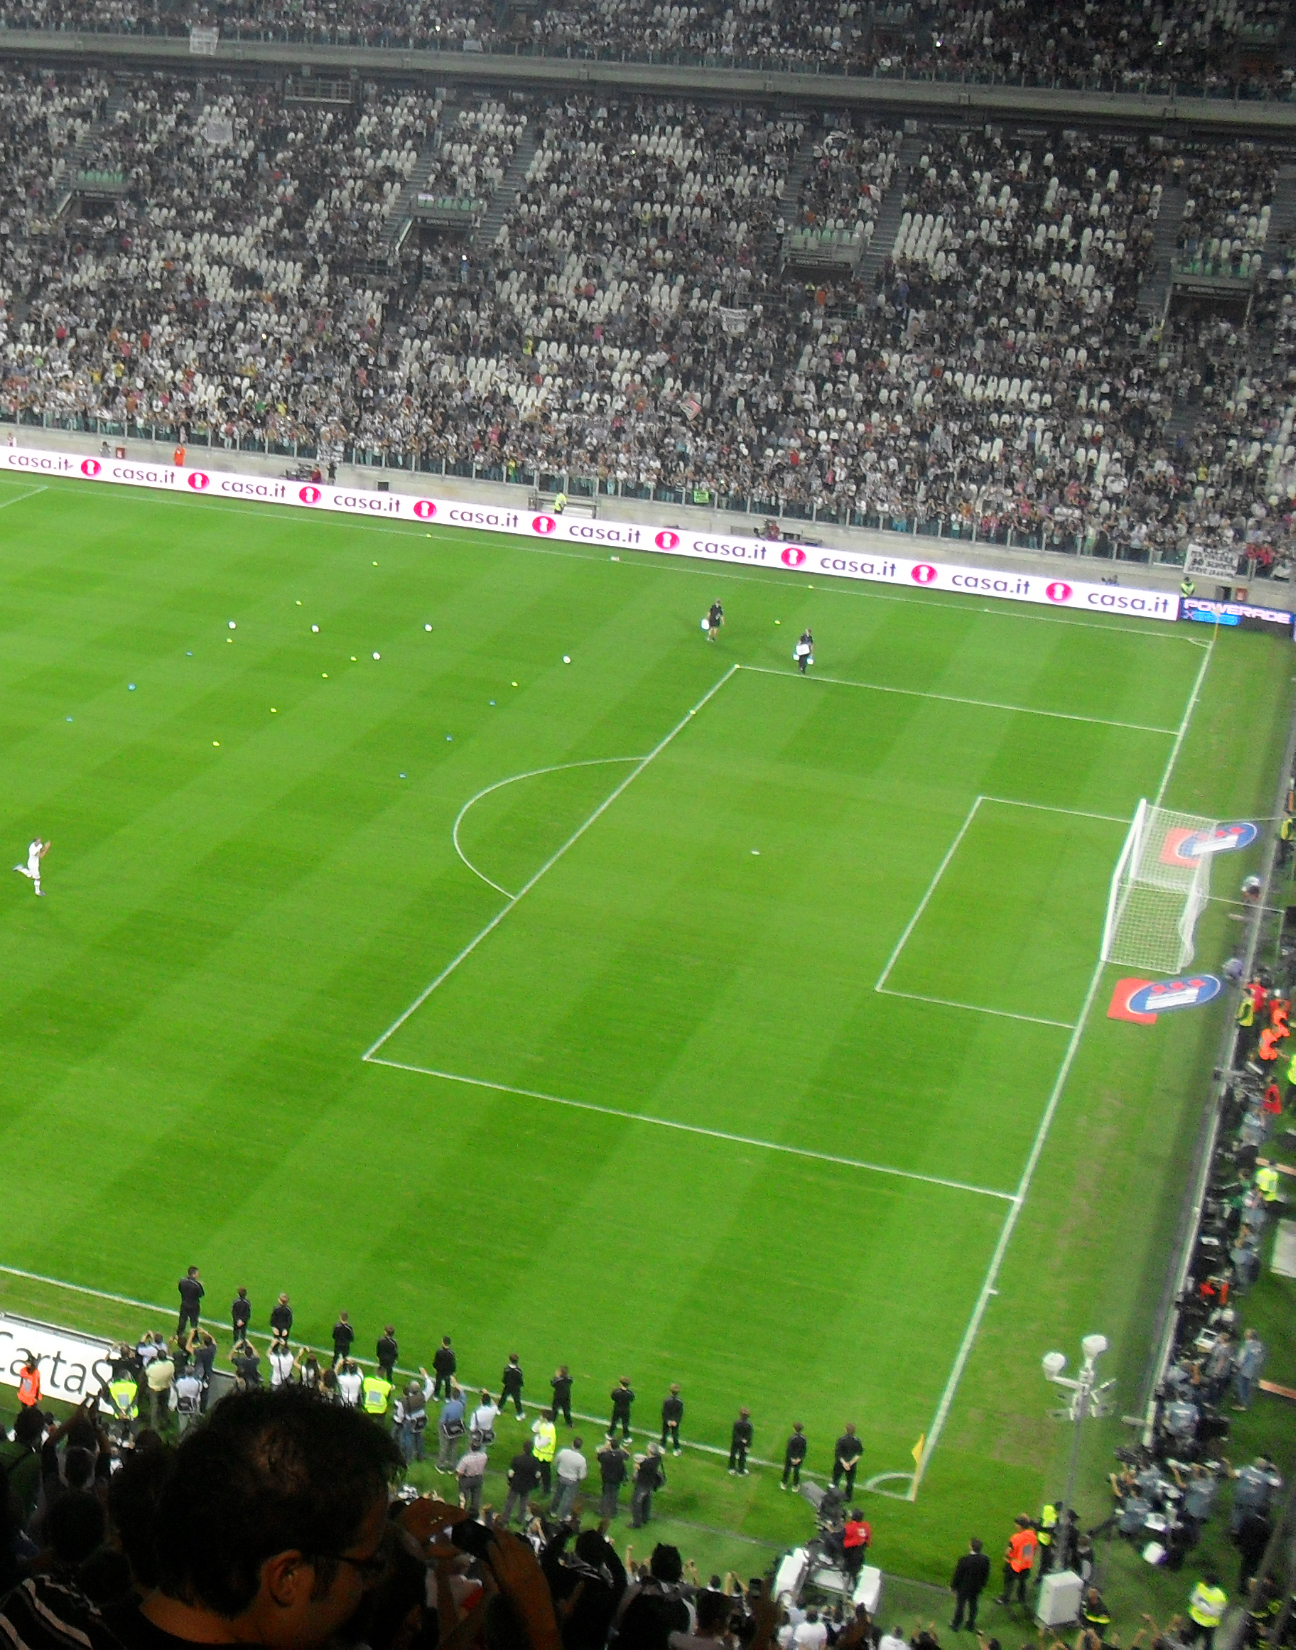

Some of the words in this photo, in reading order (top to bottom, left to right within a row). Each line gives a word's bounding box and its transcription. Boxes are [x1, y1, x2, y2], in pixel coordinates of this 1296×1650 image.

[9, 454, 69, 470] casa.it
[113, 467, 174, 483] casa.it
[222, 480, 285, 497] casa.it
[334, 495, 400, 512] casa.it
[450, 509, 518, 527] casa.it
[569, 525, 640, 543] casa.it
[693, 541, 766, 559] casa.it
[821, 557, 895, 576] casa.it
[952, 574, 1029, 594] casa.it
[1088, 592, 1168, 612] casa.it
[1184, 599, 1291, 625] POWERADE
